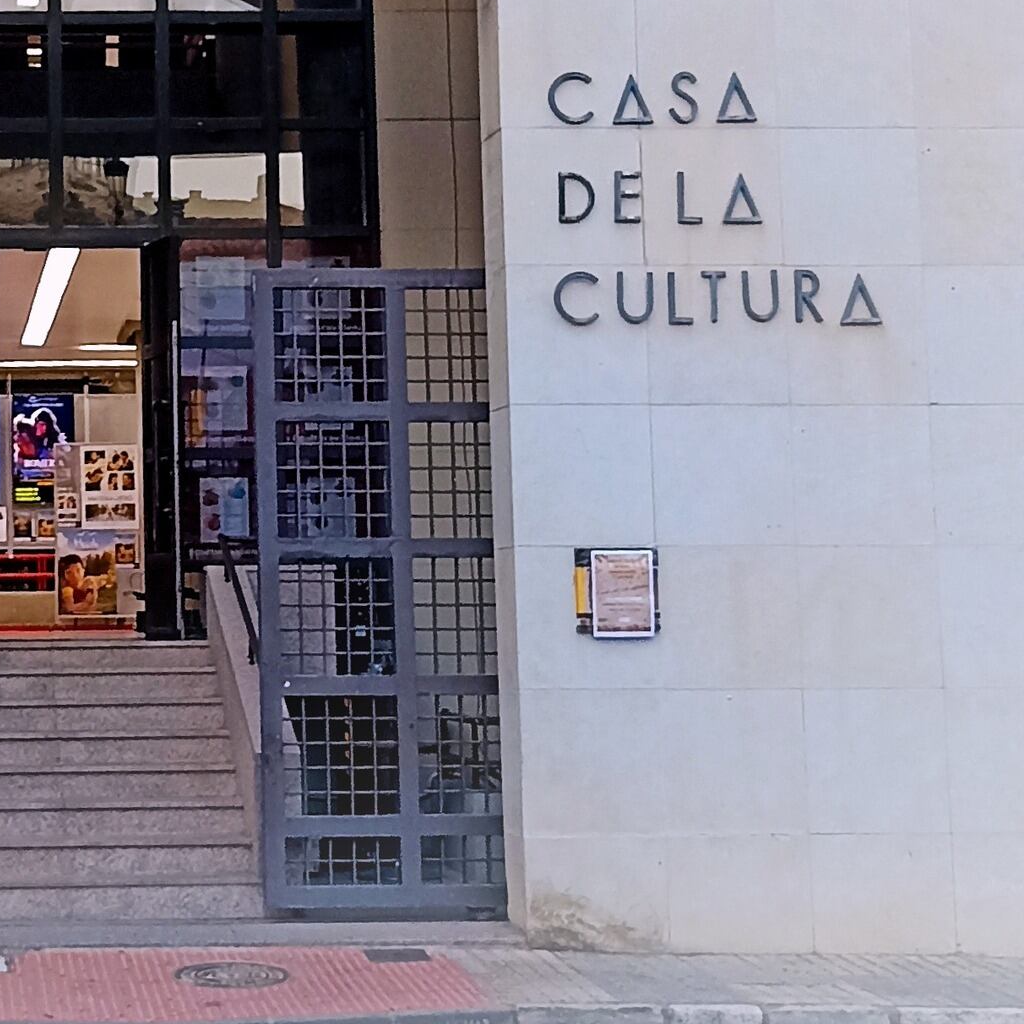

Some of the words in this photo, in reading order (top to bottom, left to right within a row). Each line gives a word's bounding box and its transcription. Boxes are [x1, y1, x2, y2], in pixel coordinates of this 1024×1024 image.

[547, 71, 758, 125] CASA
[558, 171, 641, 224] DE
[676, 171, 763, 225] LA
[553, 269, 883, 327] CULTURA
